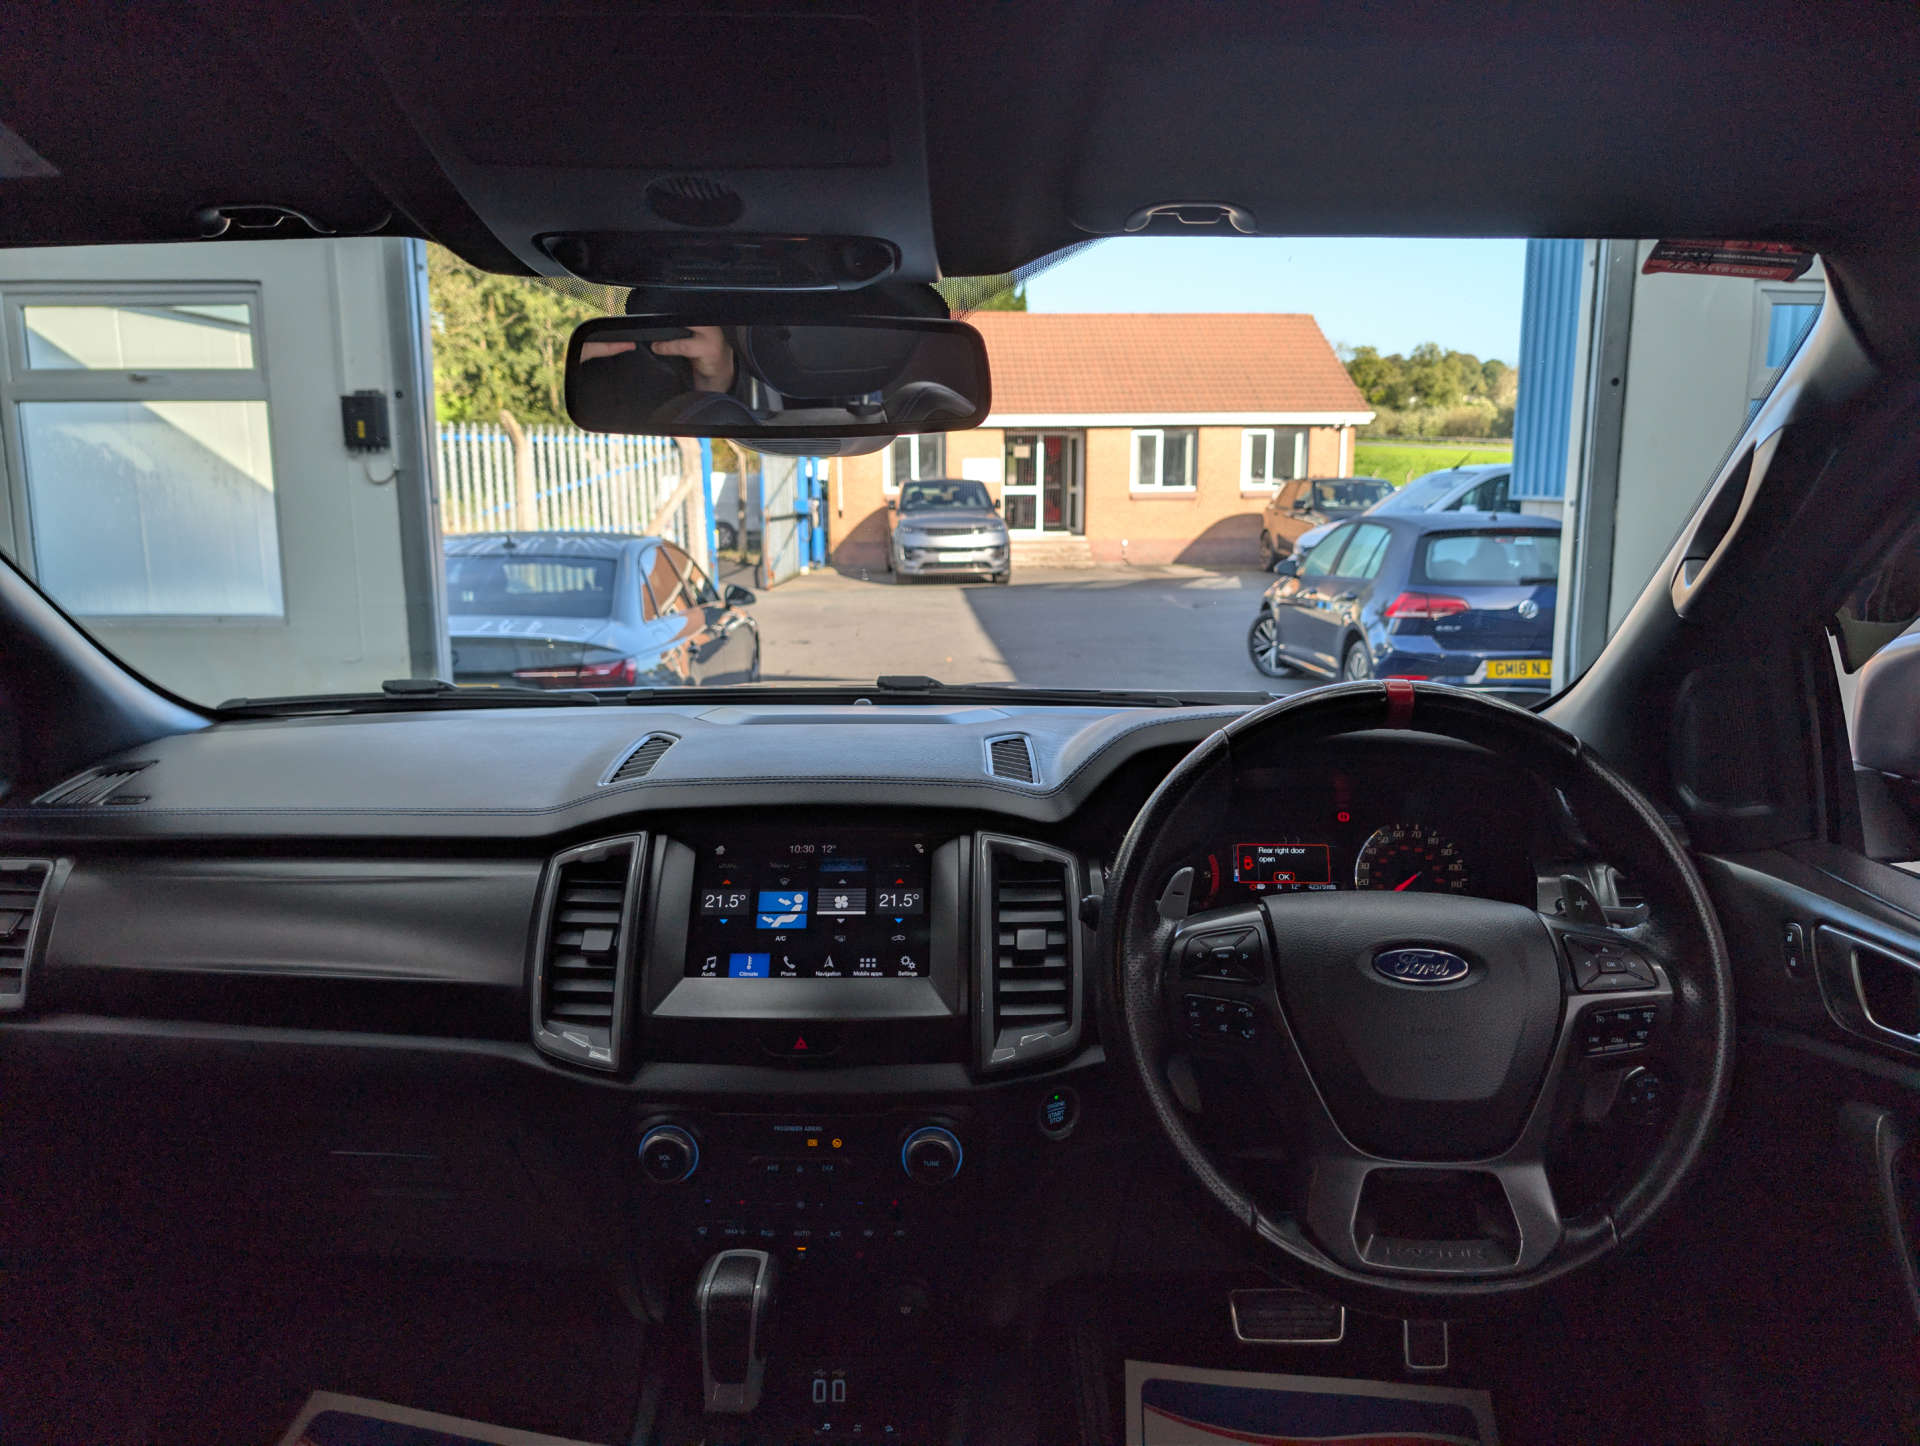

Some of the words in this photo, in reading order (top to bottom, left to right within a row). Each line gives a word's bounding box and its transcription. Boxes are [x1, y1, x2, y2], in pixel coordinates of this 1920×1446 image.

[1495, 661, 1528, 676] GM18
[1411, 830, 1422, 838] 70
[789, 844, 814, 854] 10:30
[1258, 846, 1273, 854] Rear
[1274, 846, 1289, 855] right
[1290, 846, 1305, 854] door
[1441, 848, 1452, 856] 90
[1359, 878, 1369, 886] 20
[1394, 952, 1450, 977] Ford
[815, 970, 841, 978] Navigation
[898, 970, 918, 978] Settings
